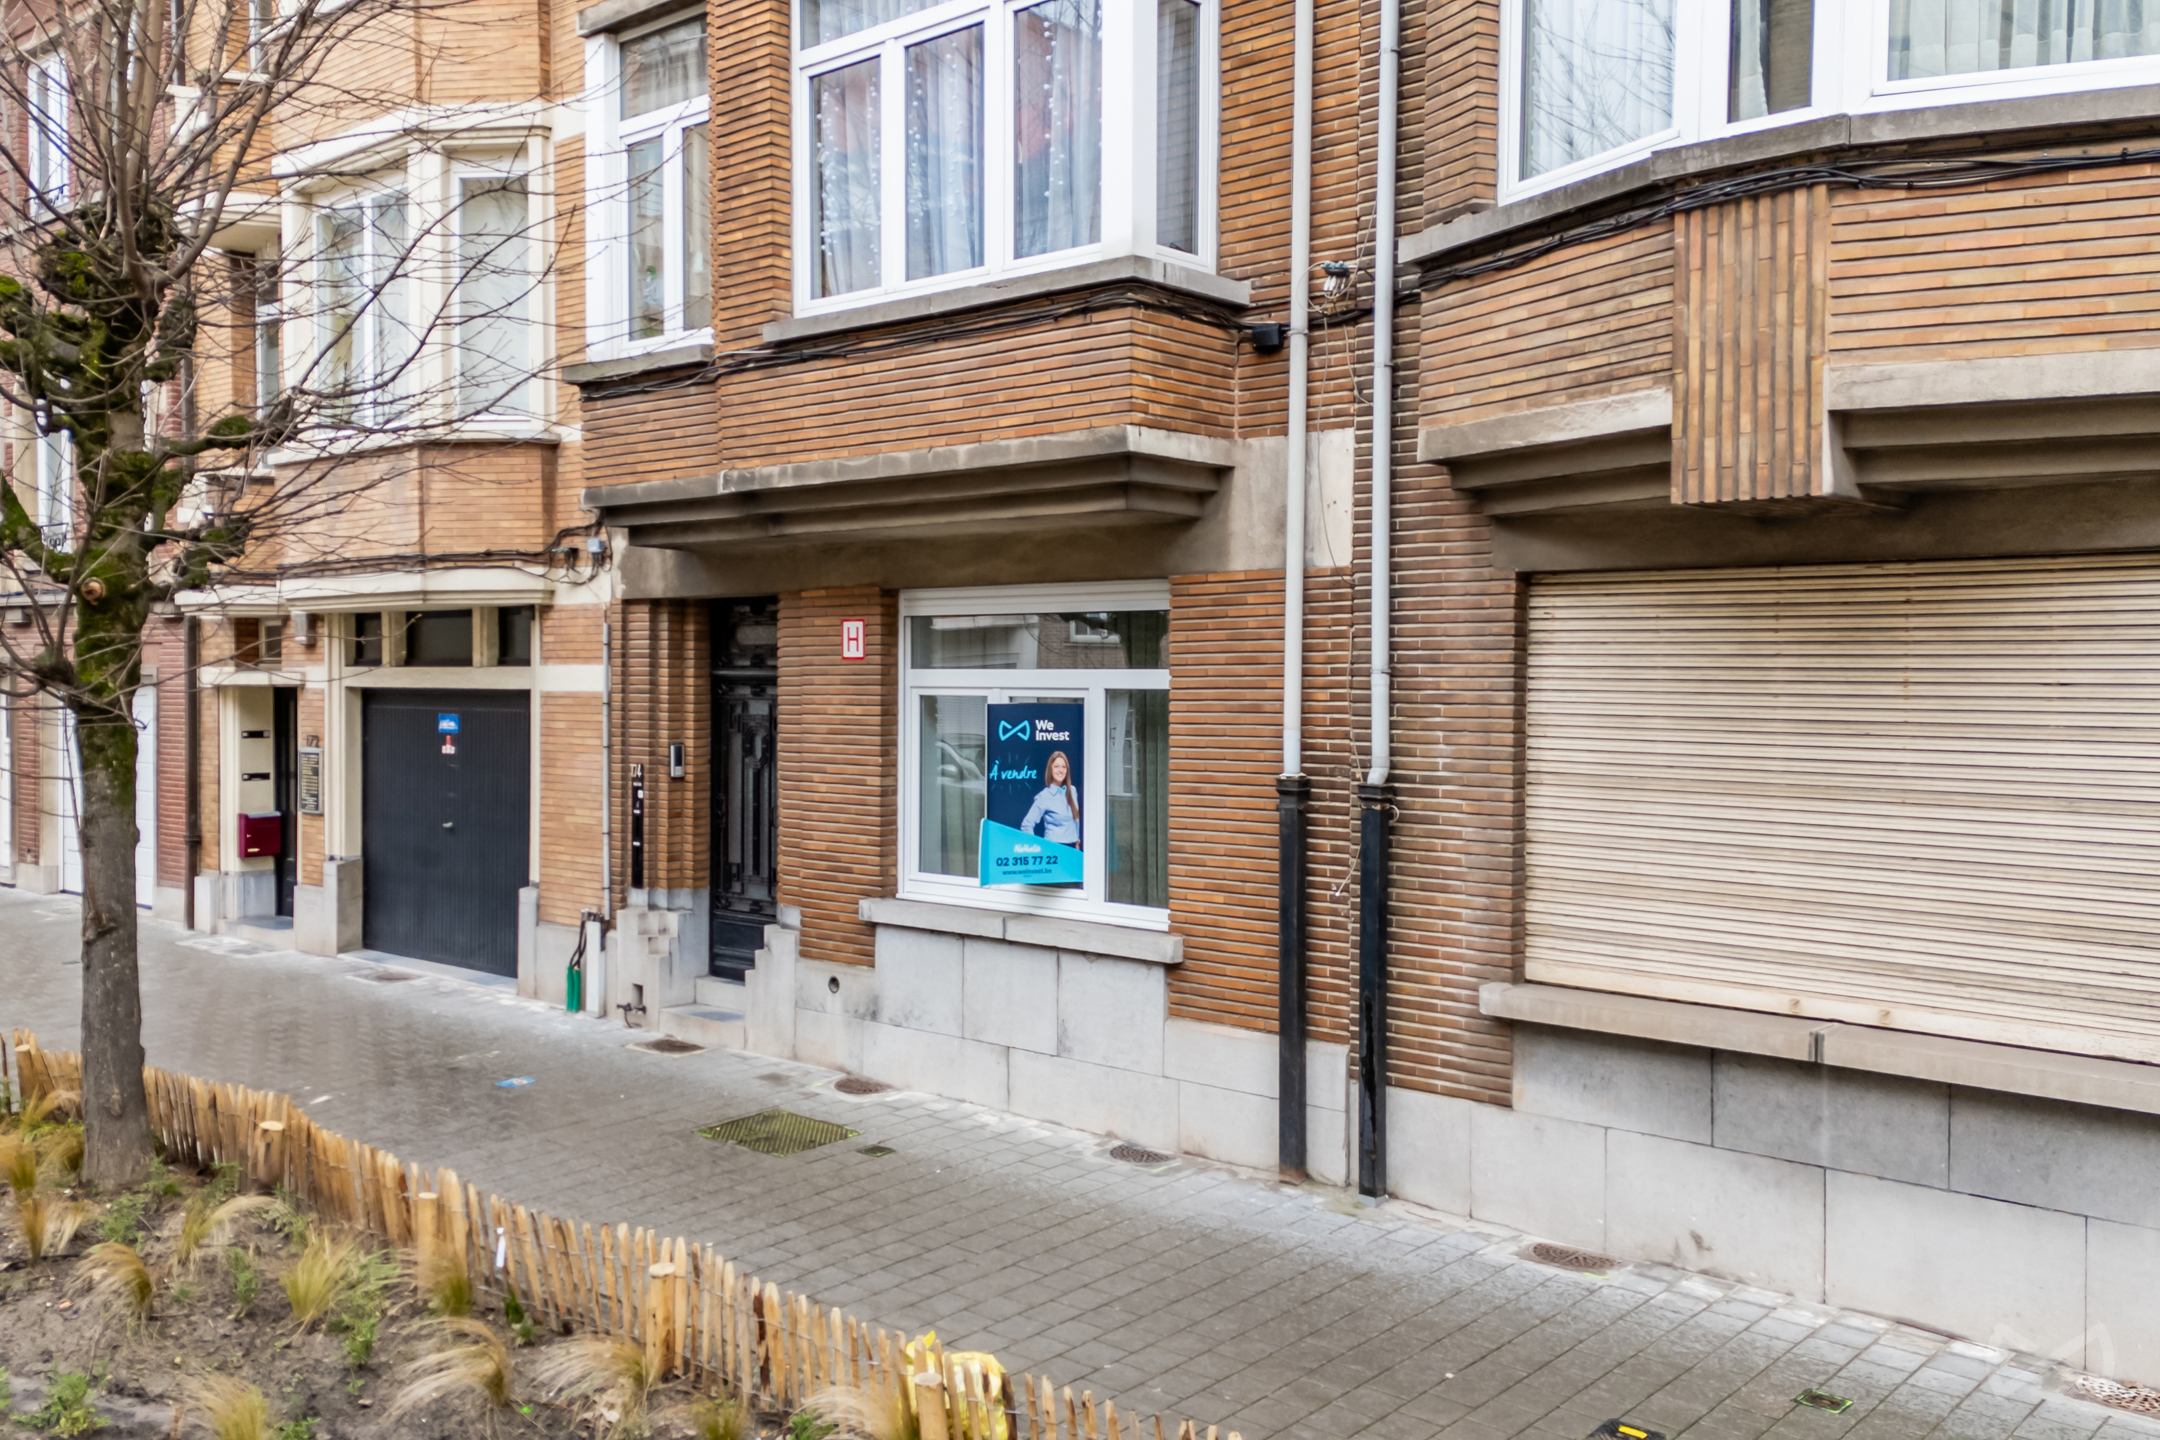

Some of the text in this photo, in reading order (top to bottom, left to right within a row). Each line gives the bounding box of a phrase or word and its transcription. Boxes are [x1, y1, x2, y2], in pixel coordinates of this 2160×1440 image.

[847, 626, 859, 652] H
[1035, 720, 1054, 731] We
[1035, 730, 1070, 741] Invest
[989, 760, 1037, 781] À vendre
[996, 855, 1059, 867] 02 315 77 22
